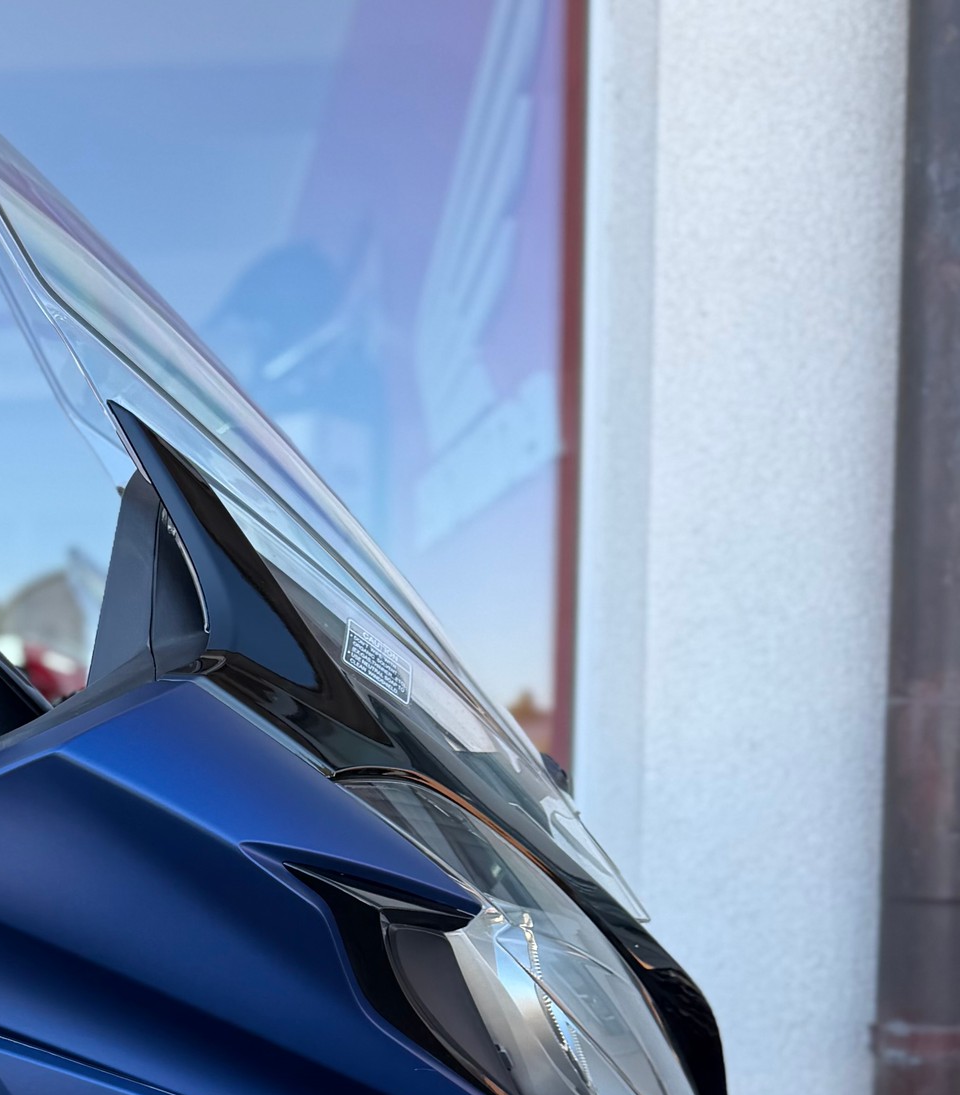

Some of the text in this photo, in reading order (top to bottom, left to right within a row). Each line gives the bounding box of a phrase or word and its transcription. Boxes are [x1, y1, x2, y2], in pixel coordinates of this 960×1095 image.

[352, 640, 374, 660] ORGANIC
[363, 632, 398, 662] CAUTION
[349, 656, 398, 694] CLEAN WINDSHIELD
[351, 650, 360, 662] USE
[362, 659, 384, 678] NEUTRAL
[384, 674, 396, 688] SOAP
